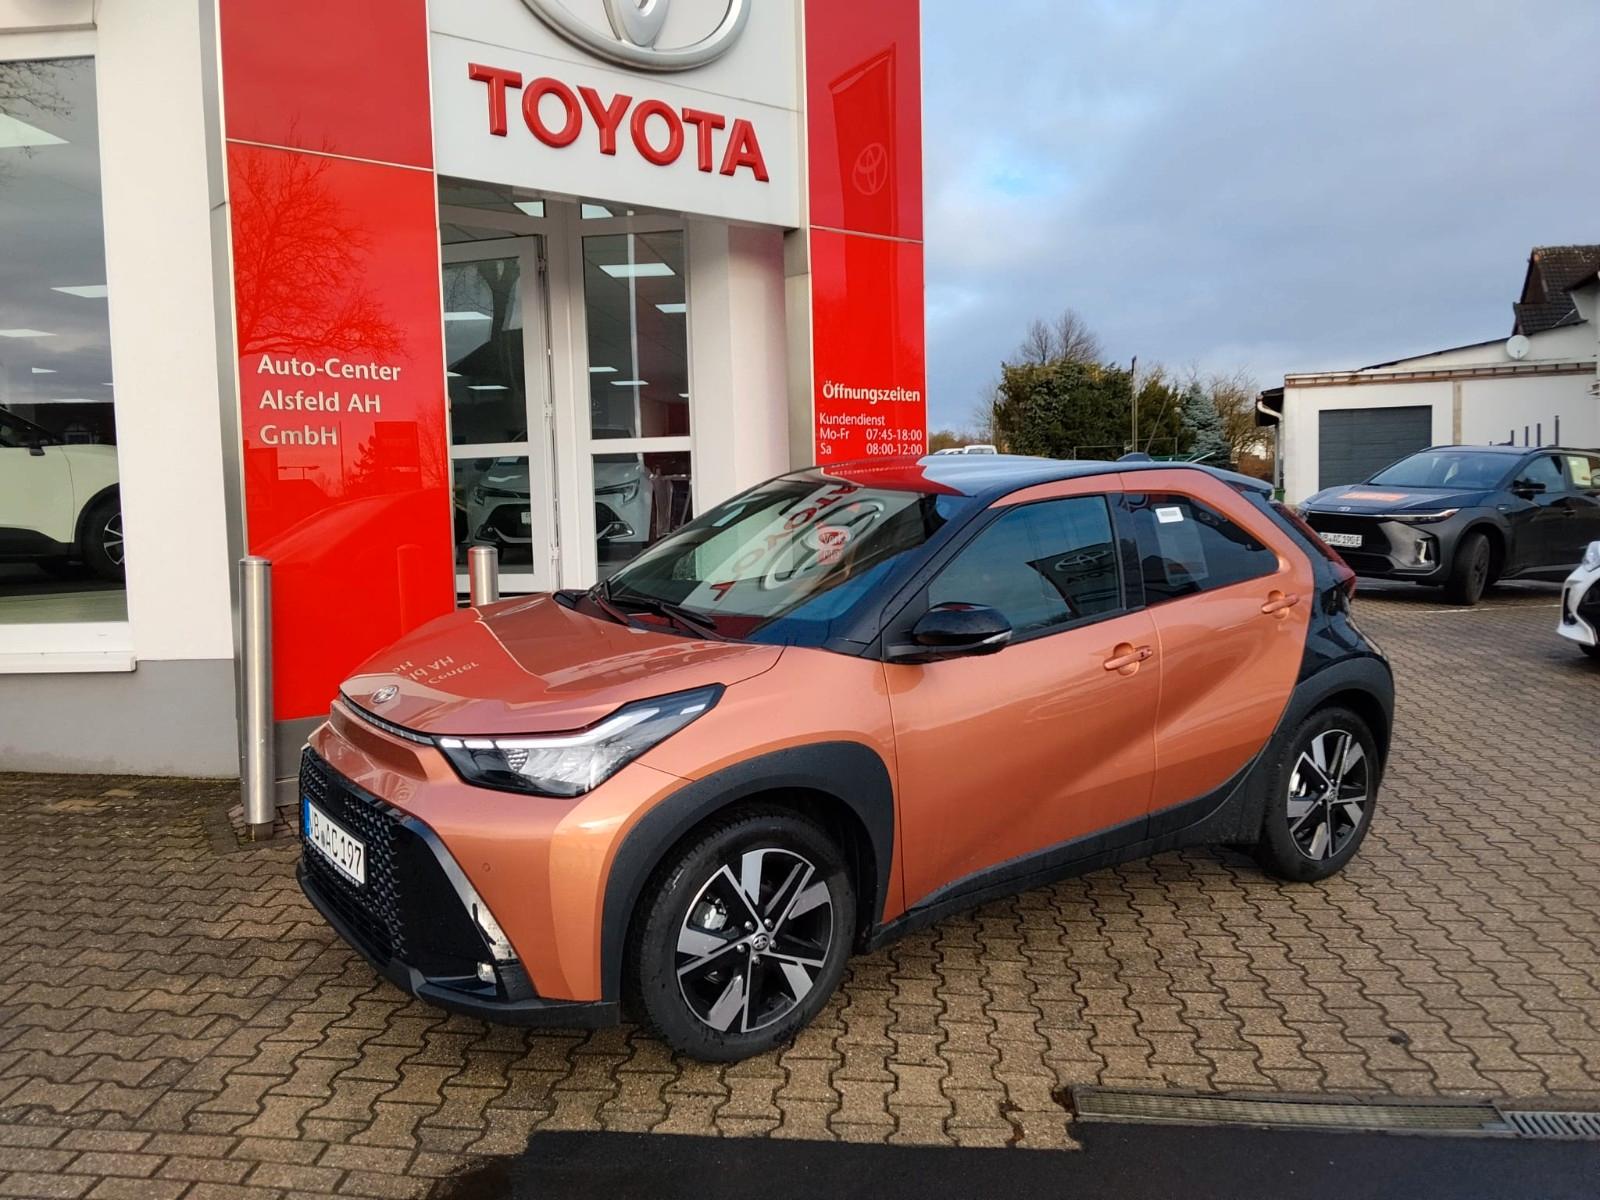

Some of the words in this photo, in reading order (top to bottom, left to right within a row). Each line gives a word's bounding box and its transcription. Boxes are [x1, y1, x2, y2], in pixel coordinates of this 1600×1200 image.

[468, 62, 769, 182] TOYOTA
[257, 354, 401, 381] Auto-Center
[259, 389, 340, 412] Alsfeld
[347, 393, 381, 413] AH
[822, 380, 920, 405] Öffnungszeiten
[819, 412, 885, 426] Kundendienst
[260, 424, 337, 446] GmbH
[820, 428, 850, 440] Mo-Fr
[866, 428, 922, 441] 07:45-18:00
[820, 443, 832, 455] Sa
[866, 443, 922, 455] 08:00-12:00
[341, 836, 362, 875] 197
